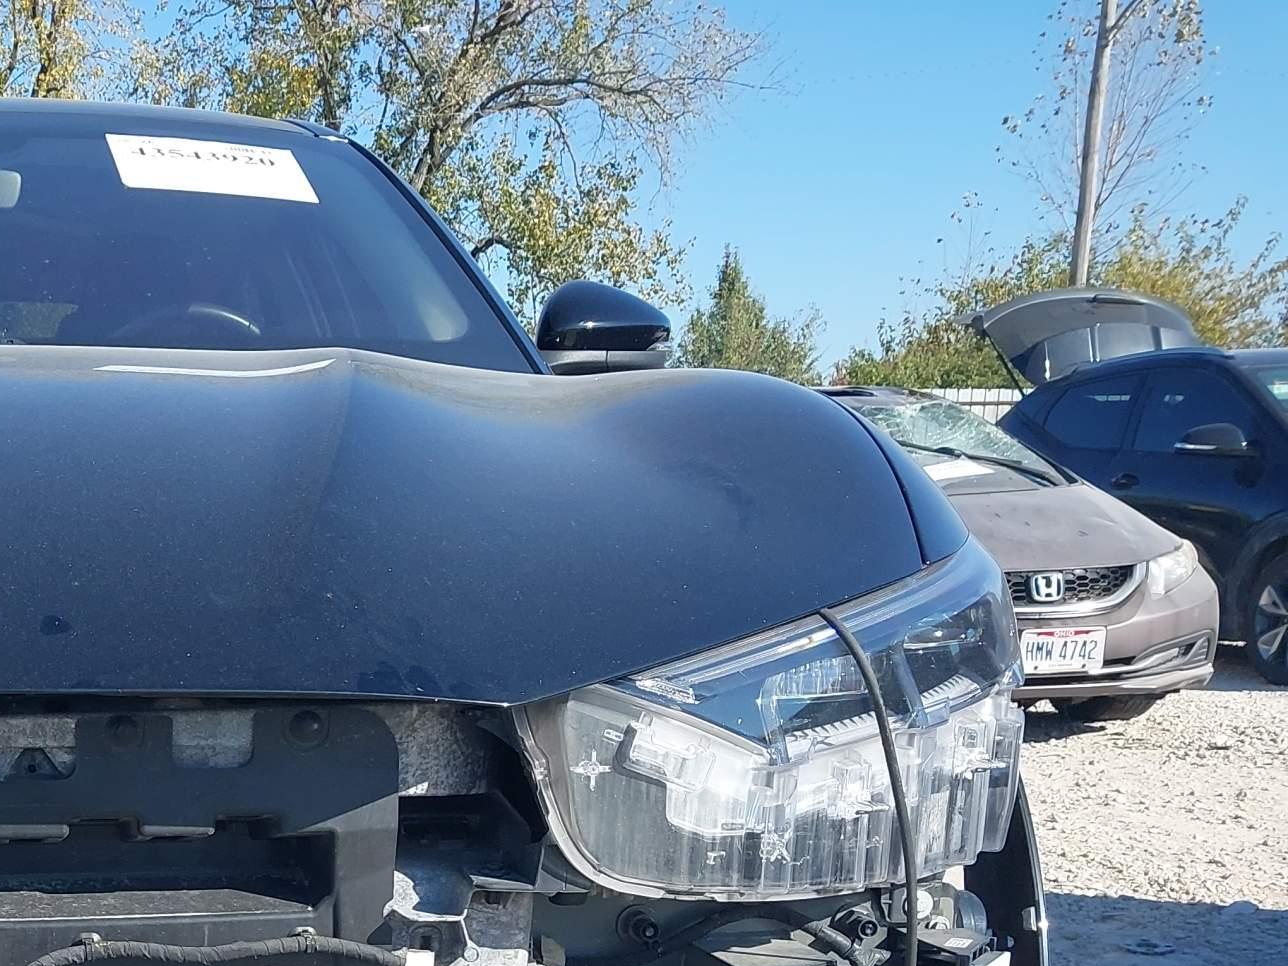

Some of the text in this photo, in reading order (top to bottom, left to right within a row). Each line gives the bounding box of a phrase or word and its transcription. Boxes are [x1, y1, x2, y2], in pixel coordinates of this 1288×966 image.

[1053, 630, 1075, 638] OHIO
[1025, 639, 1098, 662] HMW 4742
